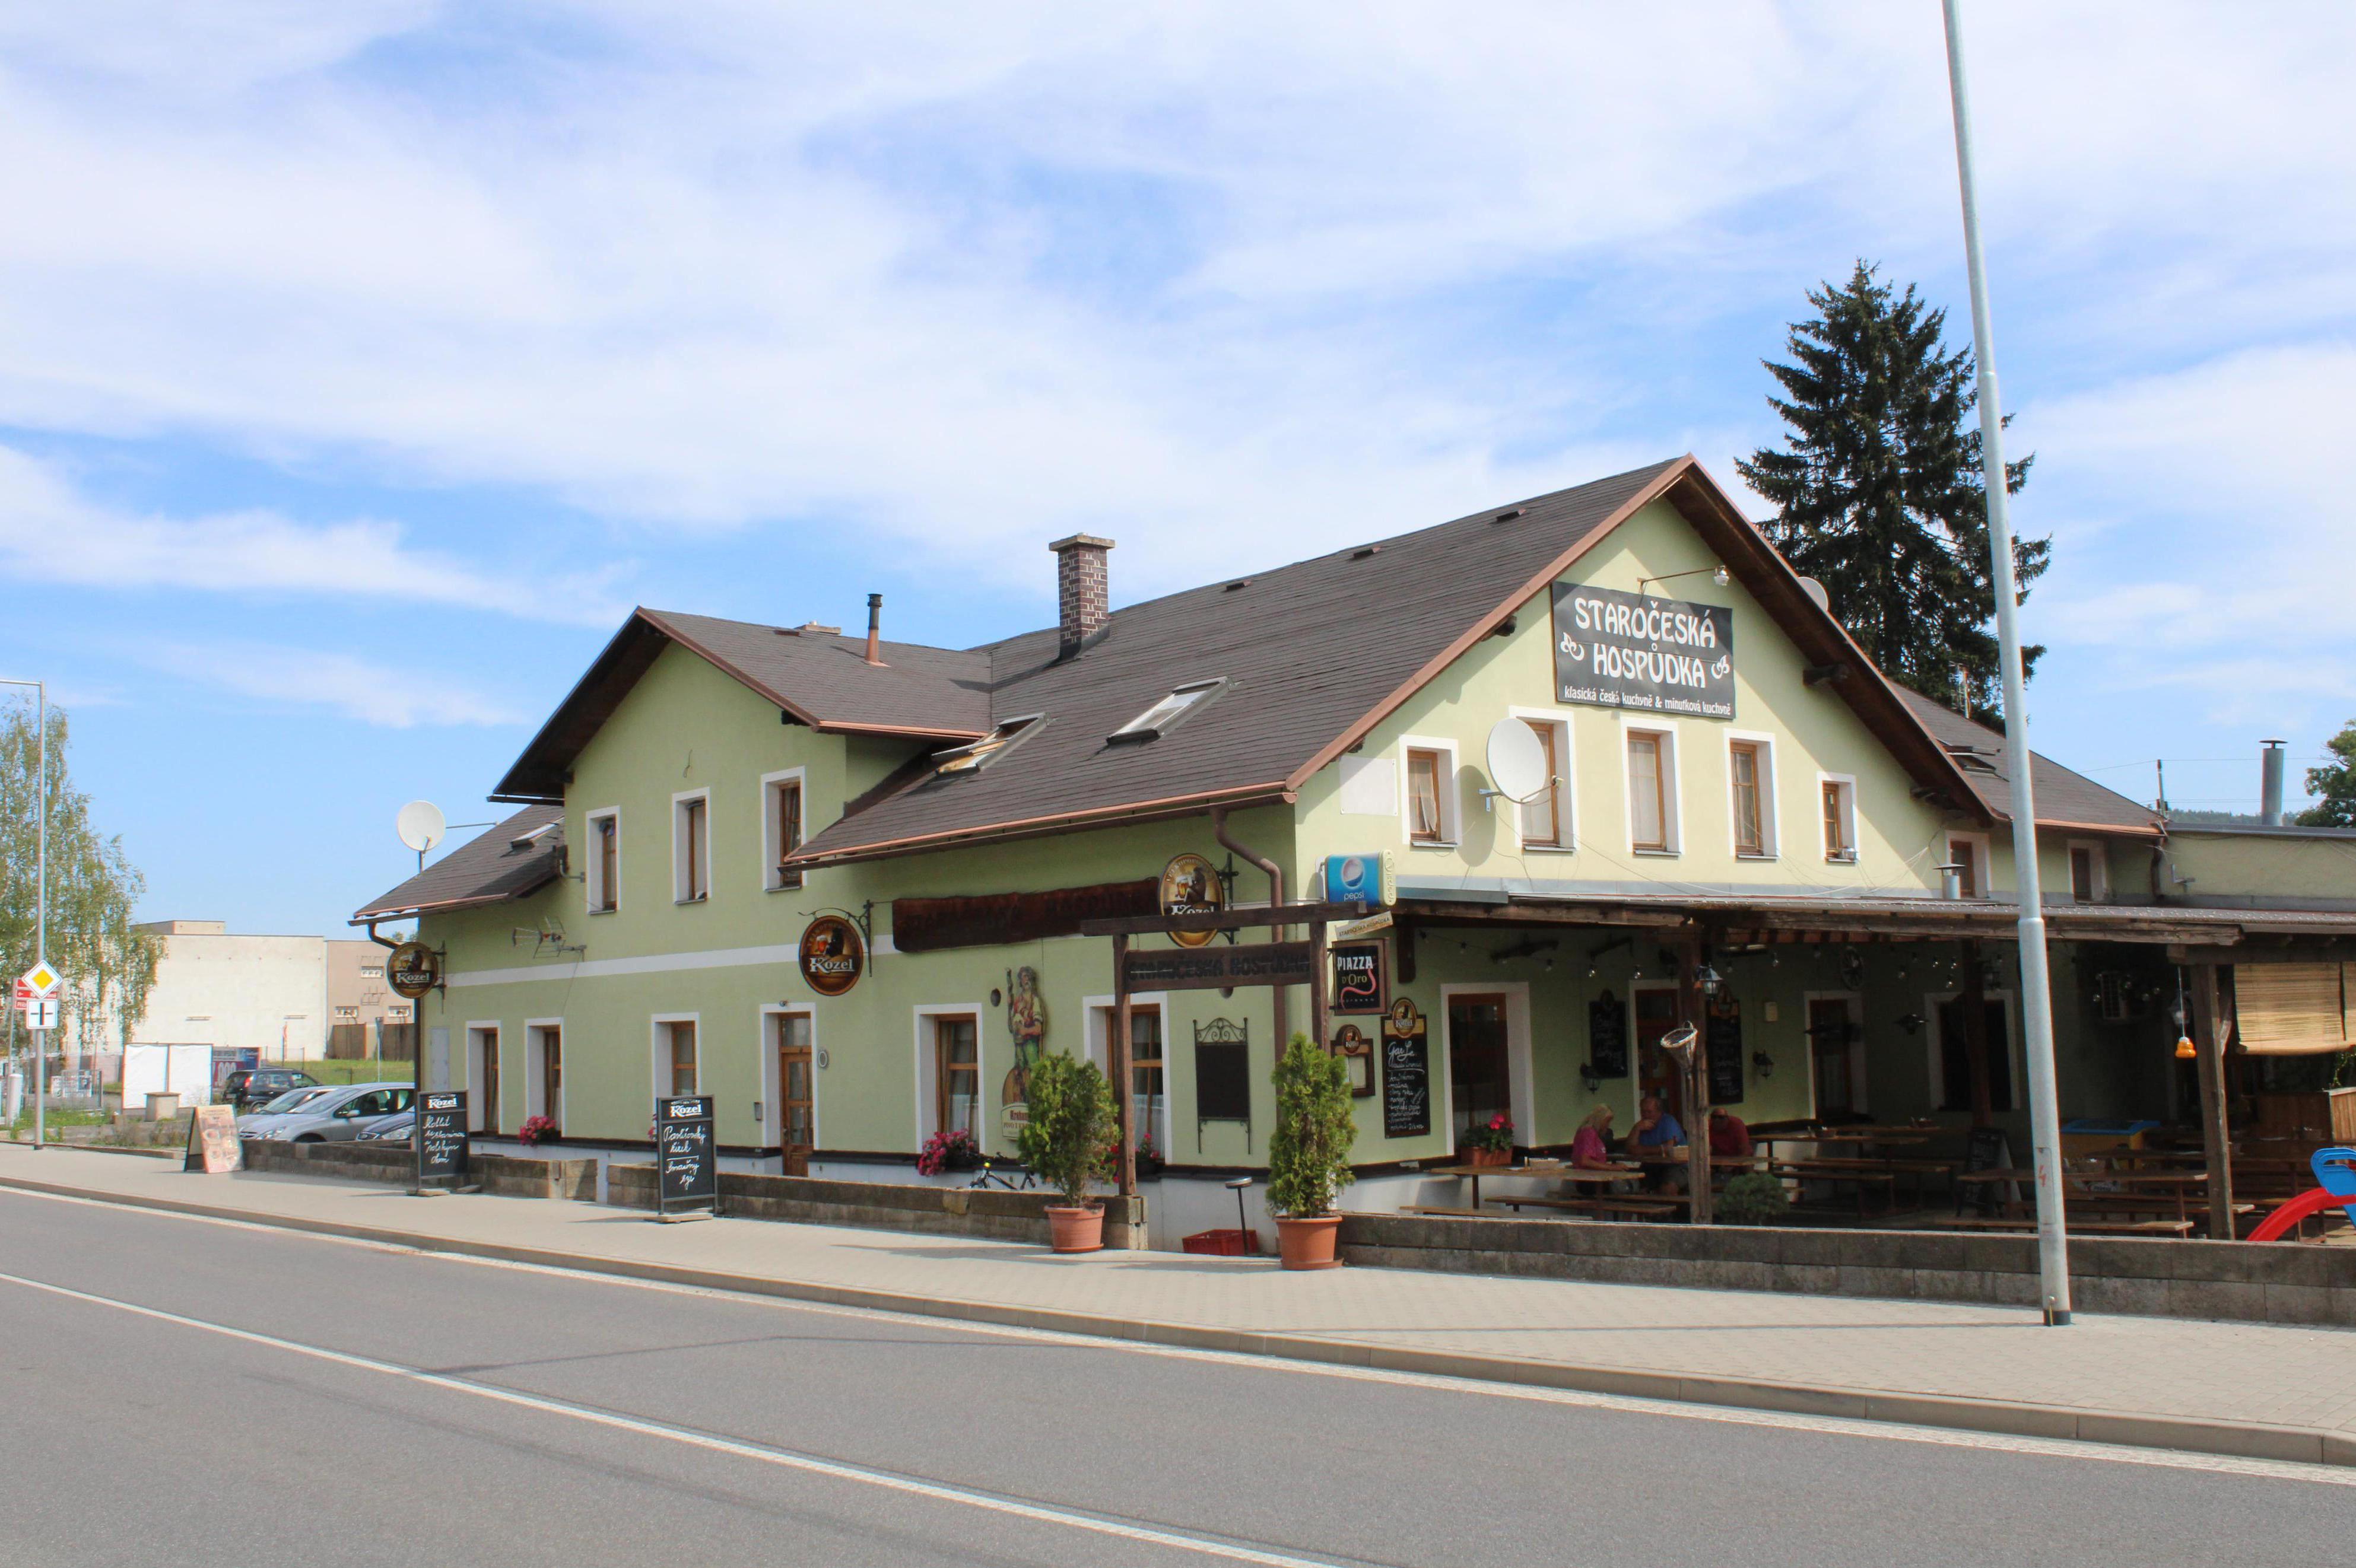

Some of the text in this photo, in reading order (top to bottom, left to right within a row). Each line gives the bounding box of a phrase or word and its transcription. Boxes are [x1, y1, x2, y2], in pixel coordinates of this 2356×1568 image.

[1574, 597, 1716, 648] STAROČESKÁ
[1593, 643, 1706, 688] HOSPŮDKA
[1564, 685, 1596, 701] klasická
[1599, 688, 1620, 703] česká
[1622, 692, 1652, 707] kuchyně
[1655, 696, 1662, 708] &
[1703, 701, 1731, 715] kuchyně
[1343, 890, 1364, 901] pepsi
[809, 957, 855, 974] Kozel
[1337, 956, 1373, 971] PIAZZA
[396, 972, 430, 984] Kozel
[428, 1098, 458, 1109] Kozel
[671, 1104, 703, 1117] Kozel
